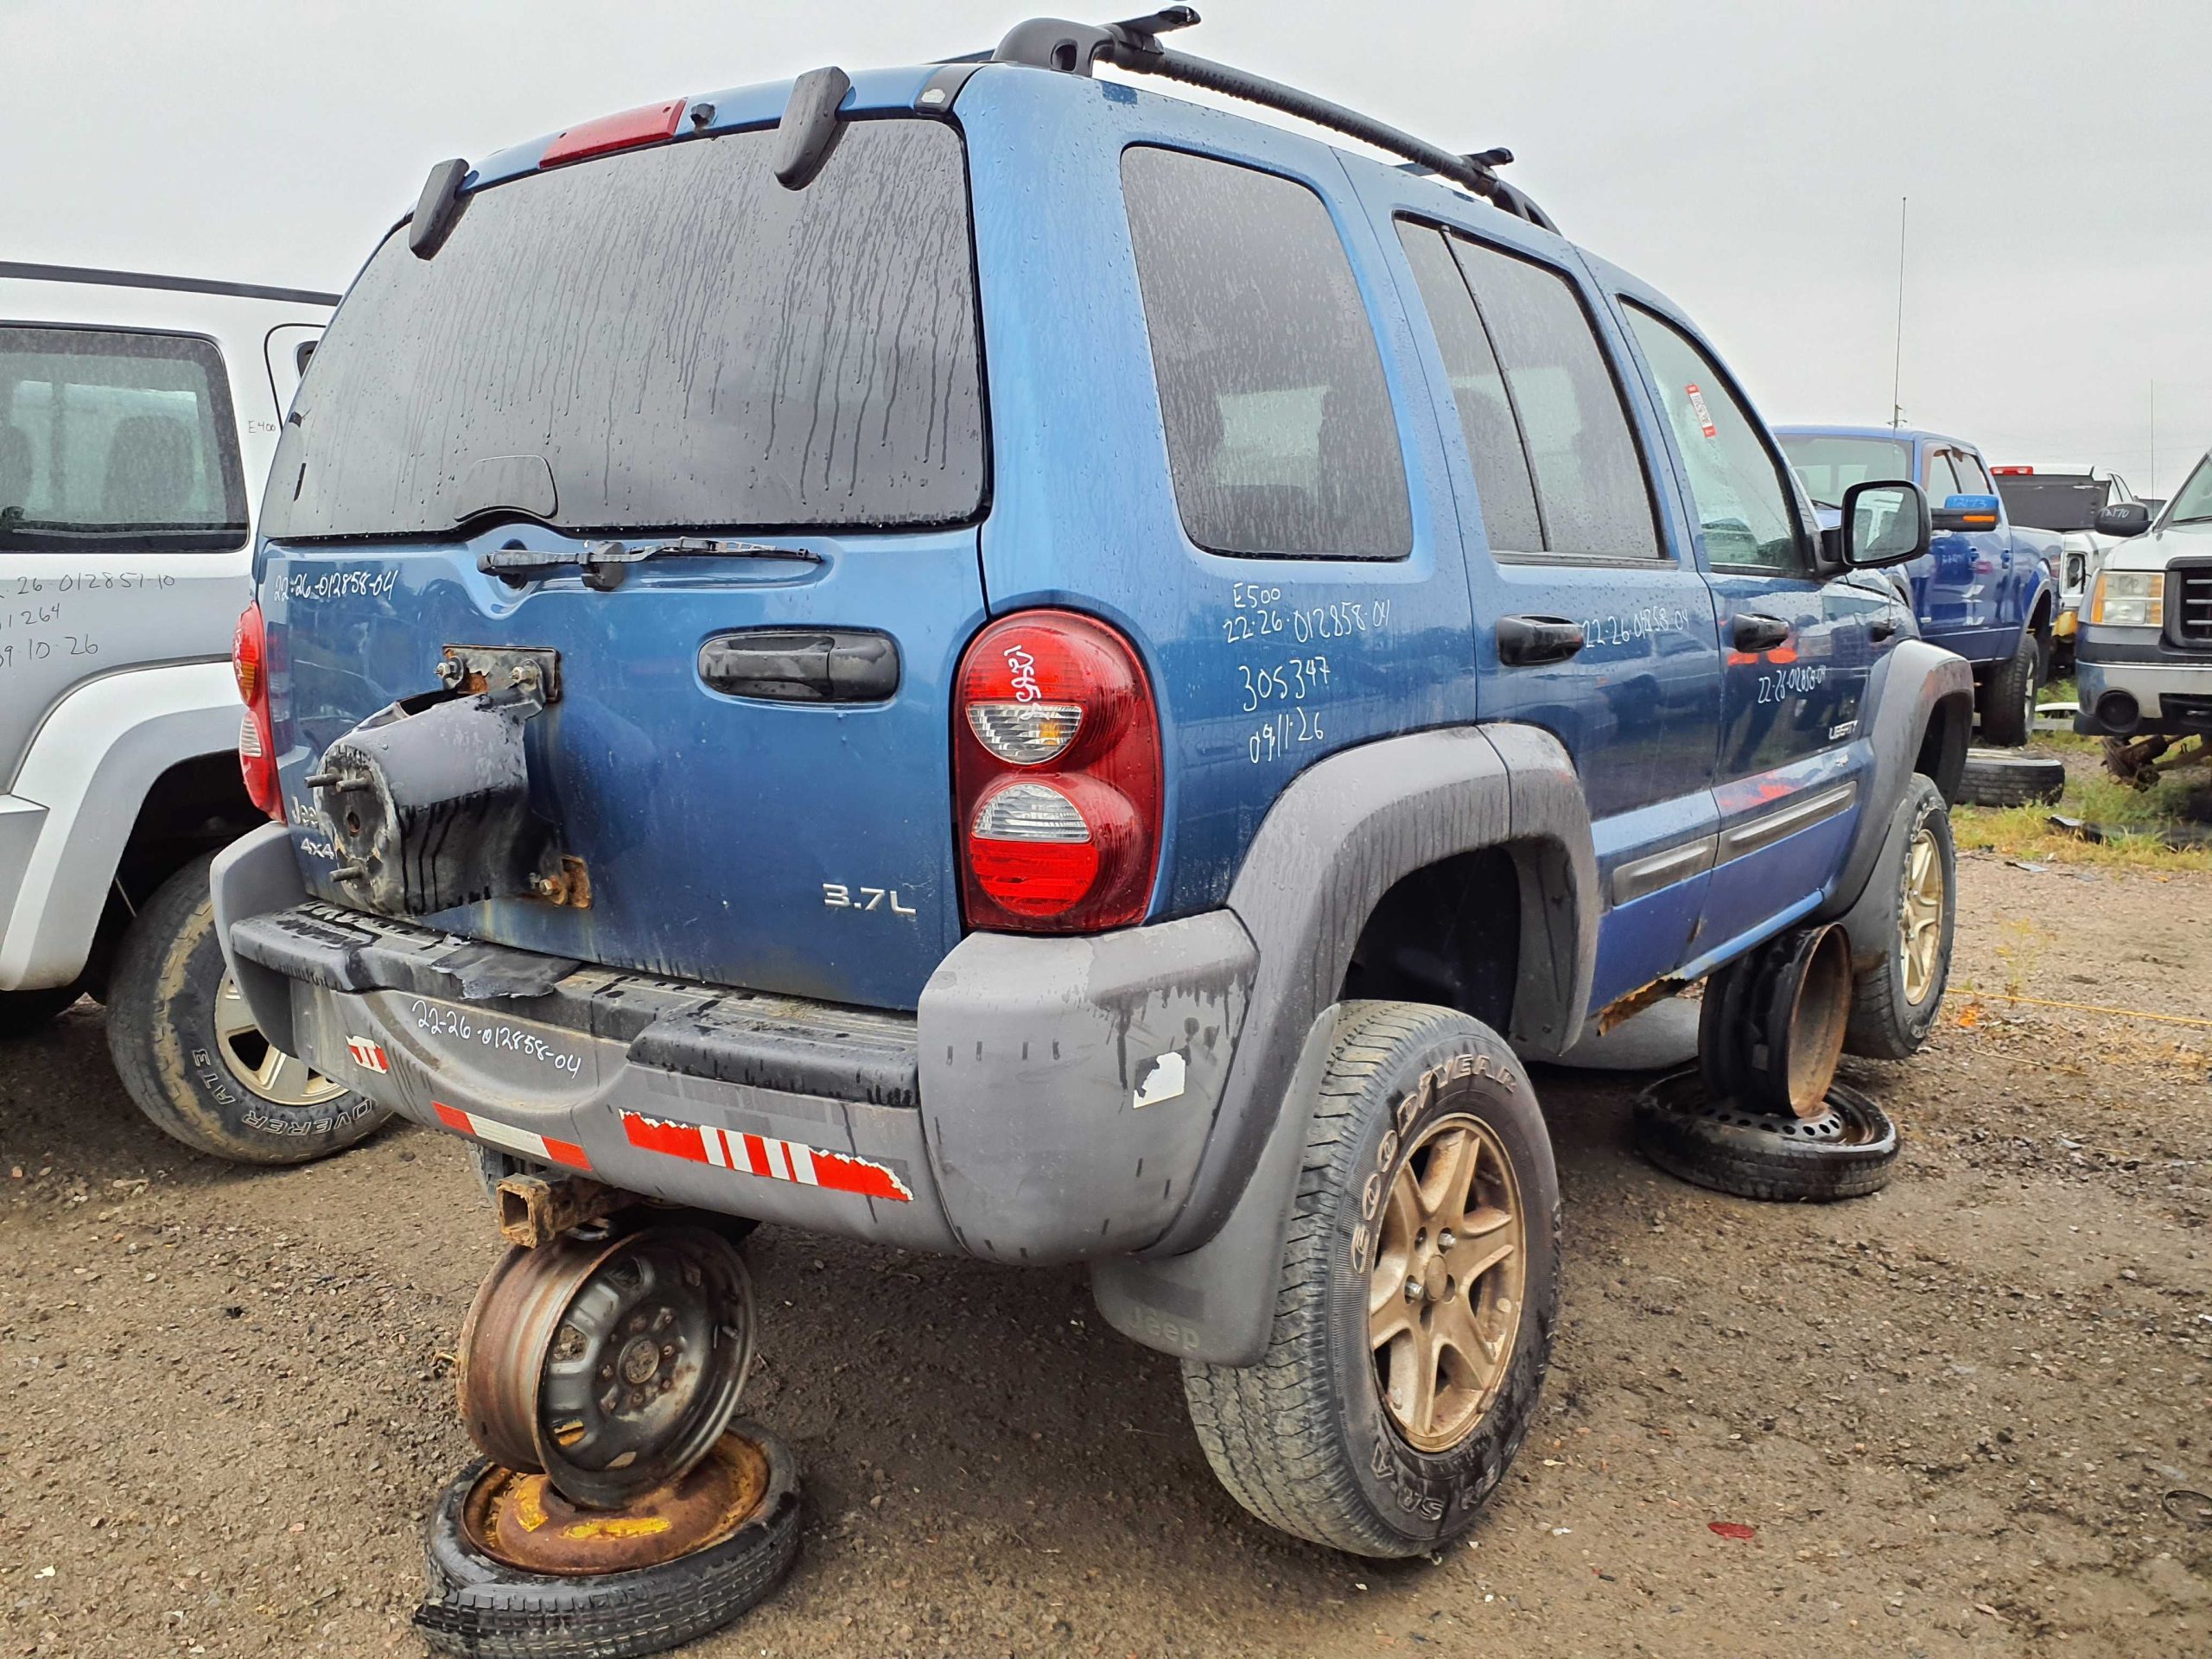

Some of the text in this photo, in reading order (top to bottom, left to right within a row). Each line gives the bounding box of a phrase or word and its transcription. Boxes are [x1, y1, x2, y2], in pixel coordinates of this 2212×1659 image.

[248, 420, 276, 434] E400
[1233, 582, 1281, 608] E500
[291, 795, 320, 829] Jee
[823, 883, 918, 915] 3.7L
[1350, 1052, 1518, 1274] GOODYEAR
[1128, 1306, 1199, 1353] Jeep
